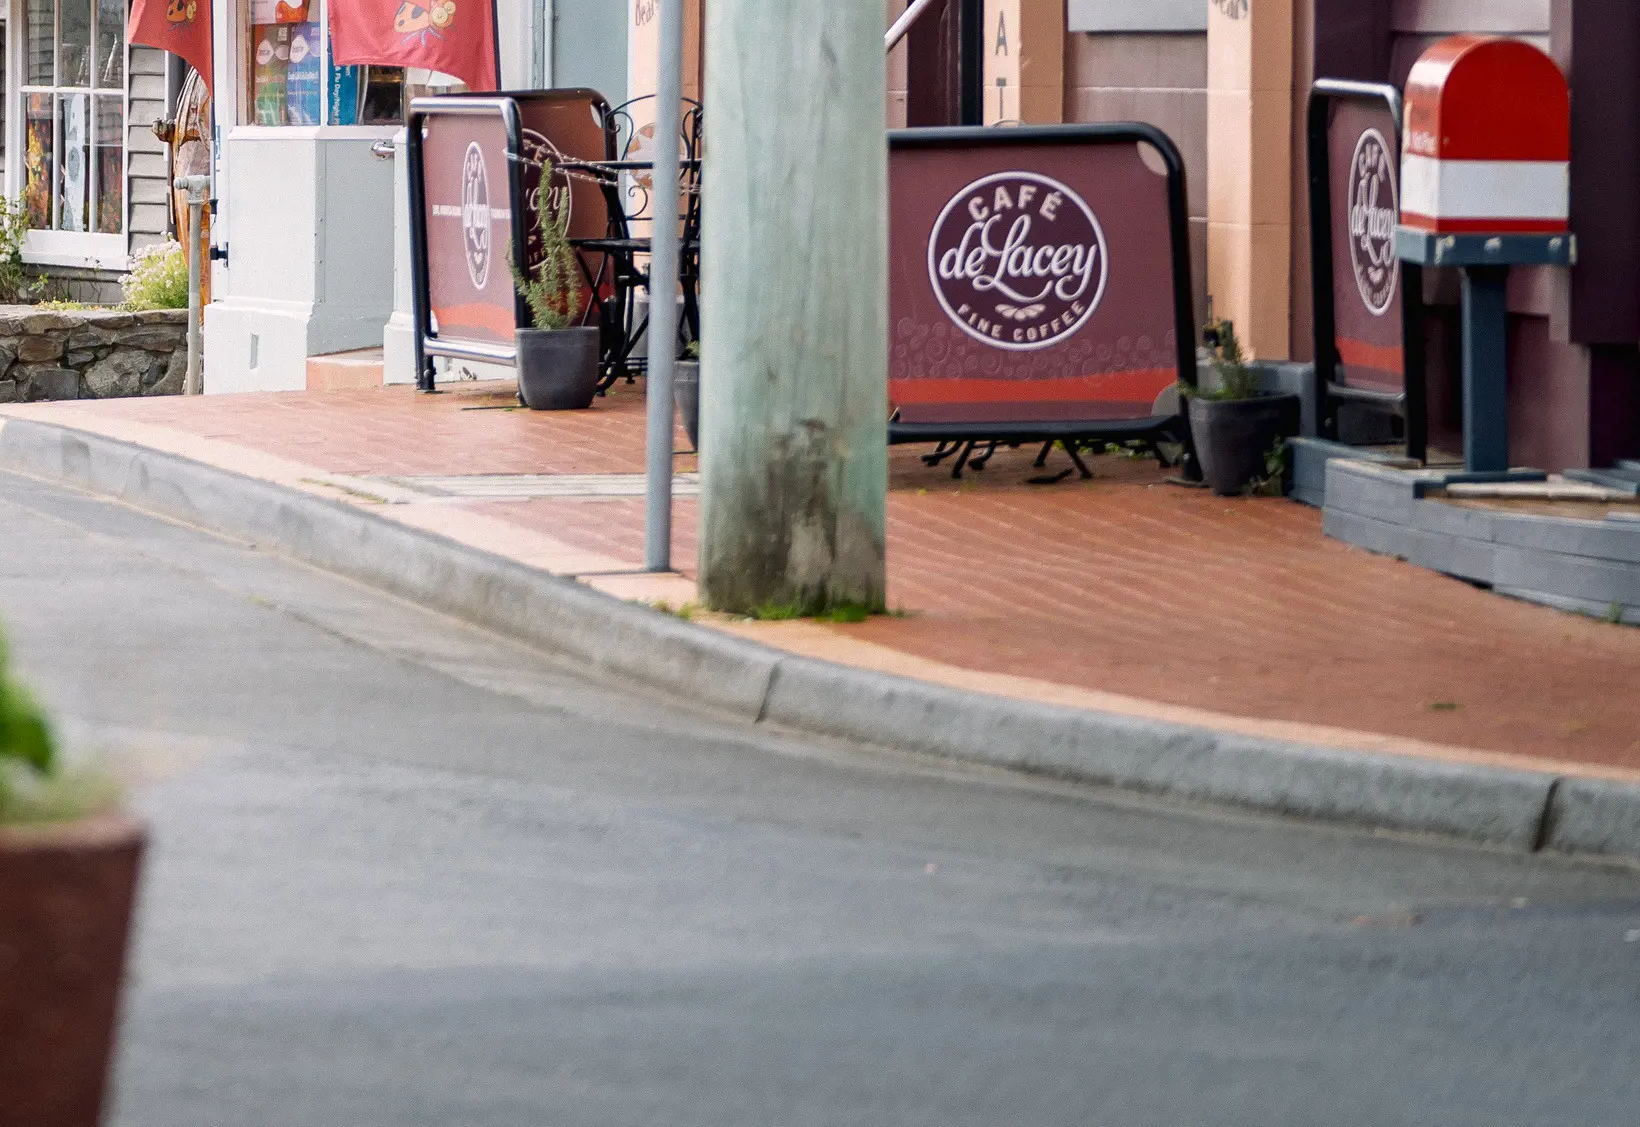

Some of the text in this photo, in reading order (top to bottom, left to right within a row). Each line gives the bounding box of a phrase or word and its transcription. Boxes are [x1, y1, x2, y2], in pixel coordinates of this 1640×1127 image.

[967, 184, 1063, 221] CAFÉ
[958, 300, 1087, 342] FINE COFFEE
